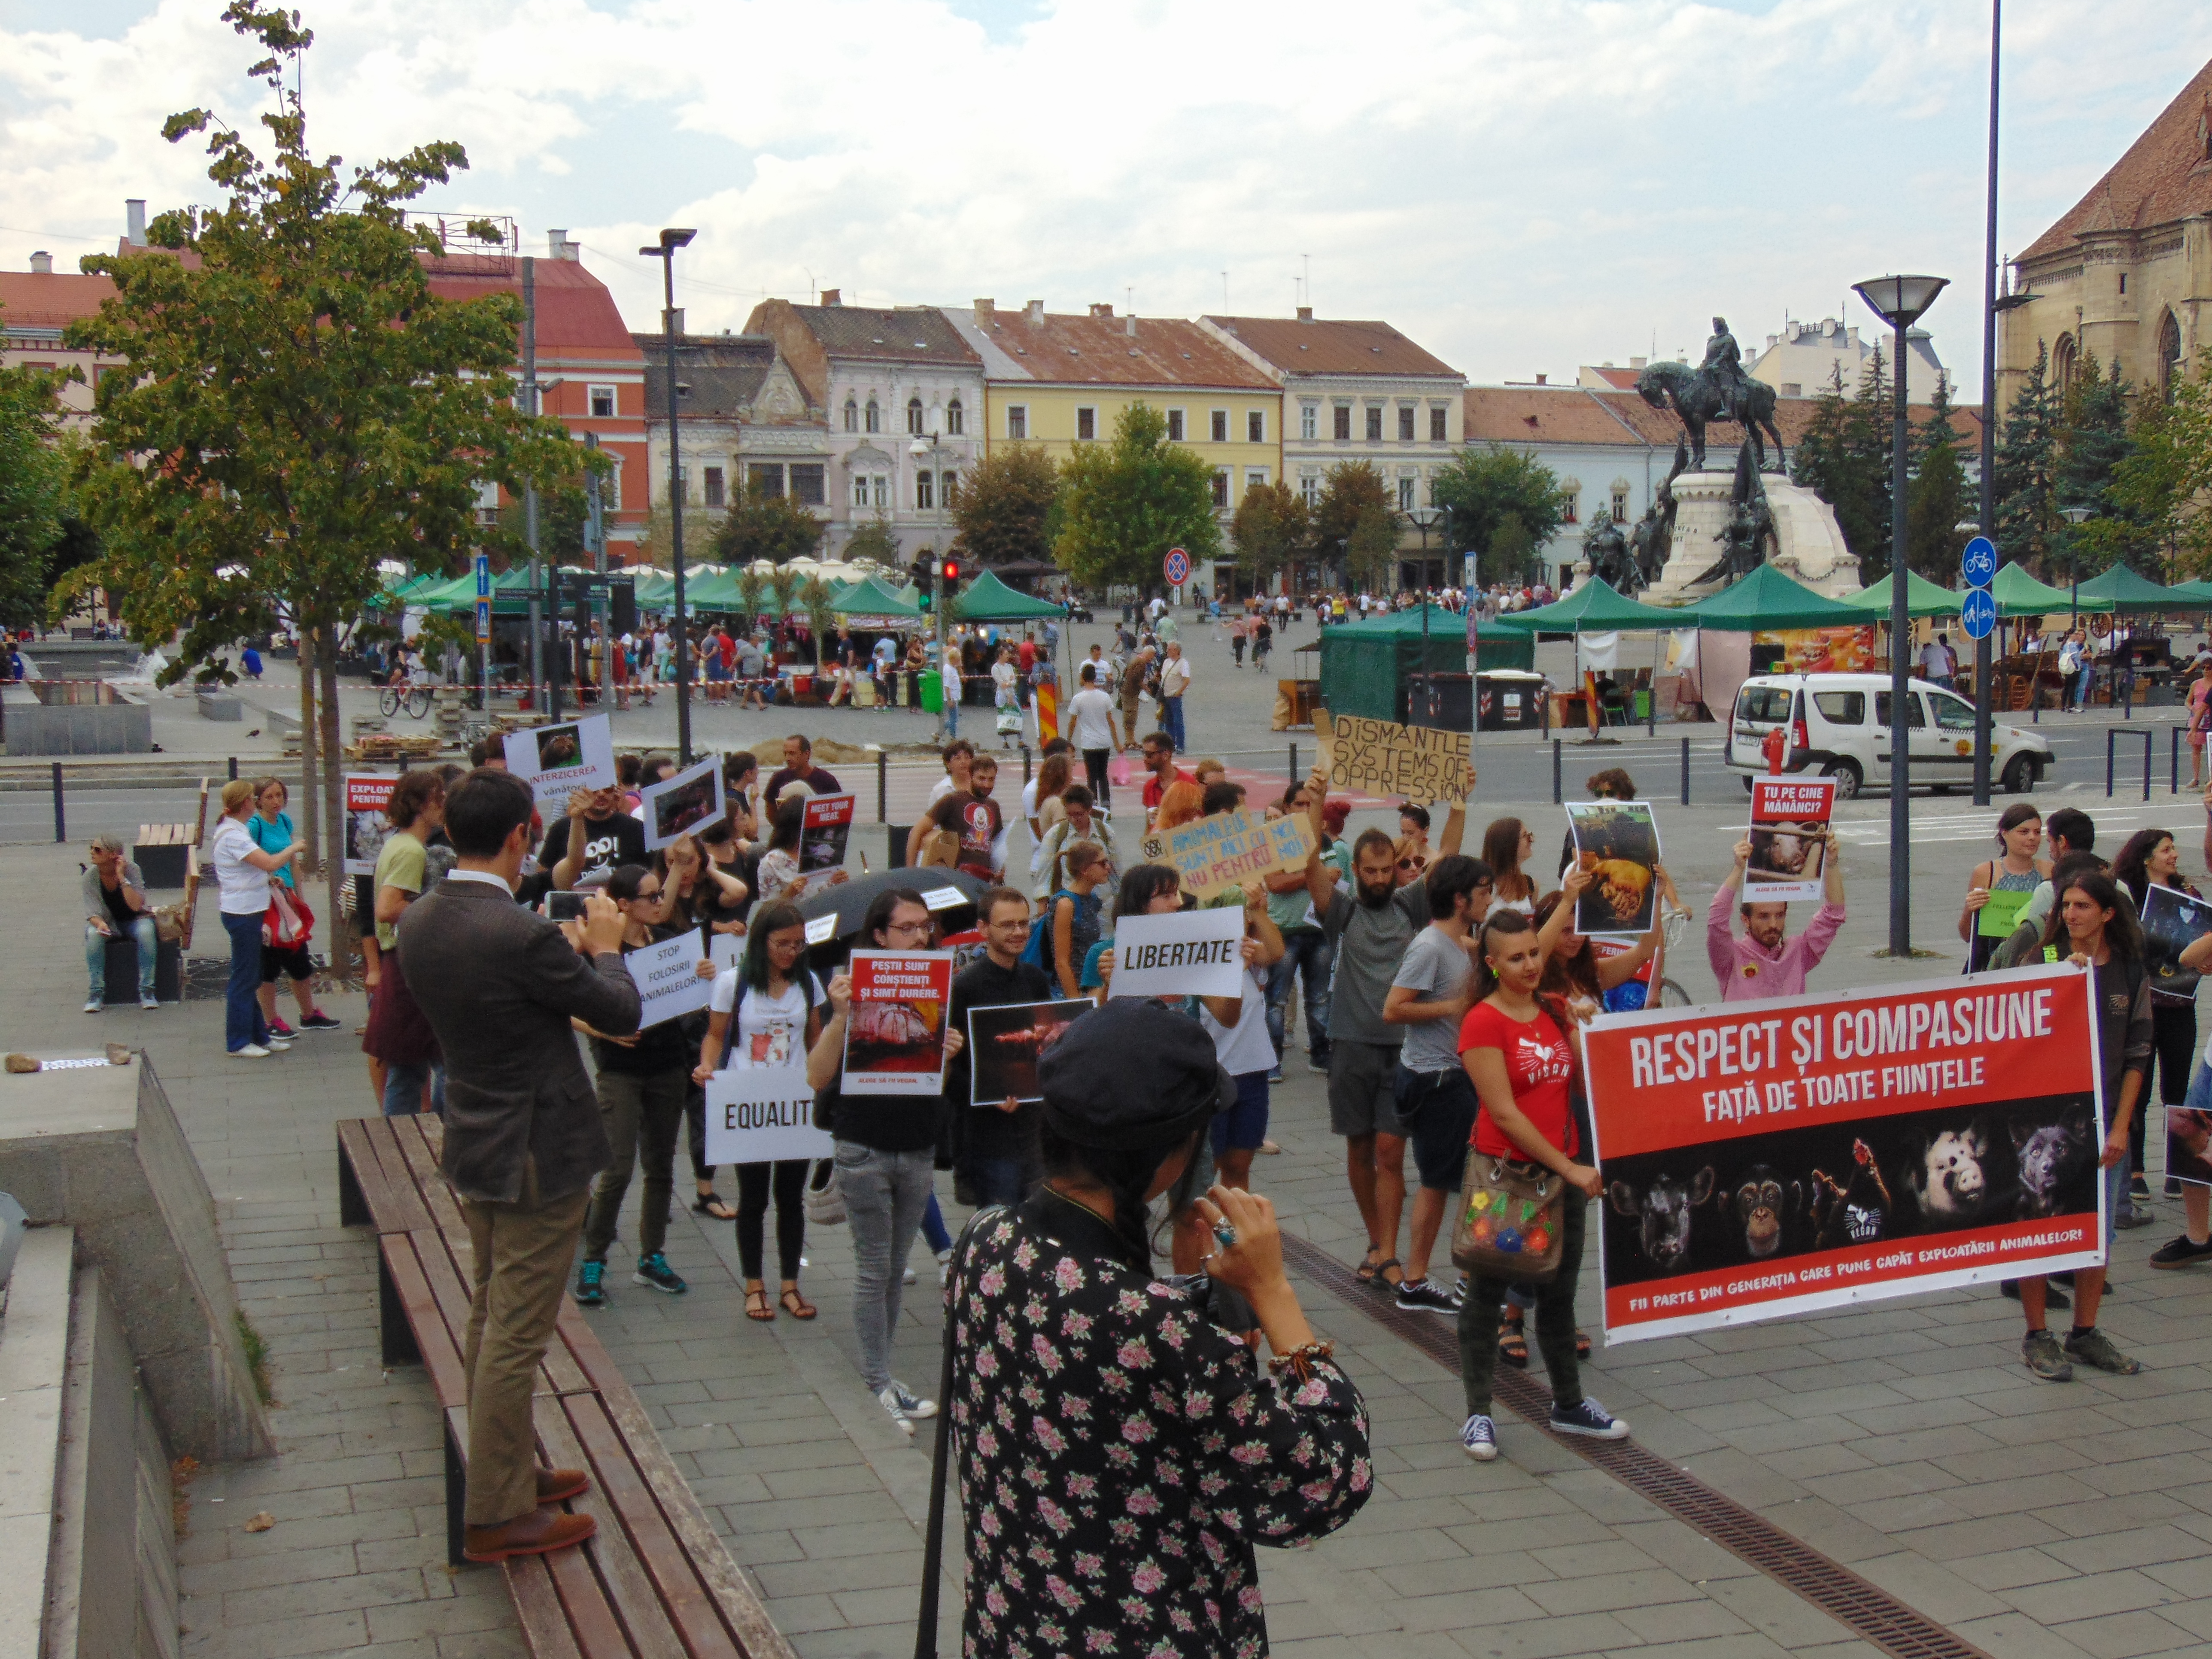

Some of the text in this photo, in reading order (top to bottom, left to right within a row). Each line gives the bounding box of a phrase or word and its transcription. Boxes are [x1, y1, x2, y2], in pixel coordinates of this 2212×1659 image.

[1334, 739, 1468, 783] SYSTEMS OF
[529, 765, 597, 784] INTERZICEREA
[352, 795, 388, 804] PENTRU
[1764, 787, 1824, 799] TU PE CINE
[811, 801, 849, 813] MEET YOUR
[1764, 799, 1822, 813] MĂNÂNCI?
[1176, 845, 1216, 874] SUNT
[1250, 830, 1266, 849] CU
[1186, 869, 1209, 890] NU
[1211, 843, 1272, 882] PENTRU
[657, 945, 680, 960] STOP
[1124, 939, 1234, 971] LIBERTATE
[648, 960, 690, 982] FOLOSIRII
[871, 960, 930, 975] PEȘTII SUNT
[640, 975, 700, 1003] ANIMALELOR!
[873, 974, 930, 988] CONȘTIENȚI
[860, 988, 940, 1001] ȘI SIMT DURERE.
[1630, 988, 2052, 1088] RESPECT ȘI COMPASIUNE
[1703, 1057, 1984, 1124] FAȚĂ DE TOATE FIINȚELE
[725, 1099, 814, 1130] EQUALIT
[1850, 1225, 1876, 1239] VEGAN
[1629, 1228, 2082, 1312] FII PARTE DIN GENERAȚIA CARE PUNE CAPĂT EXPLOATĂRII ANIMALELOR!
